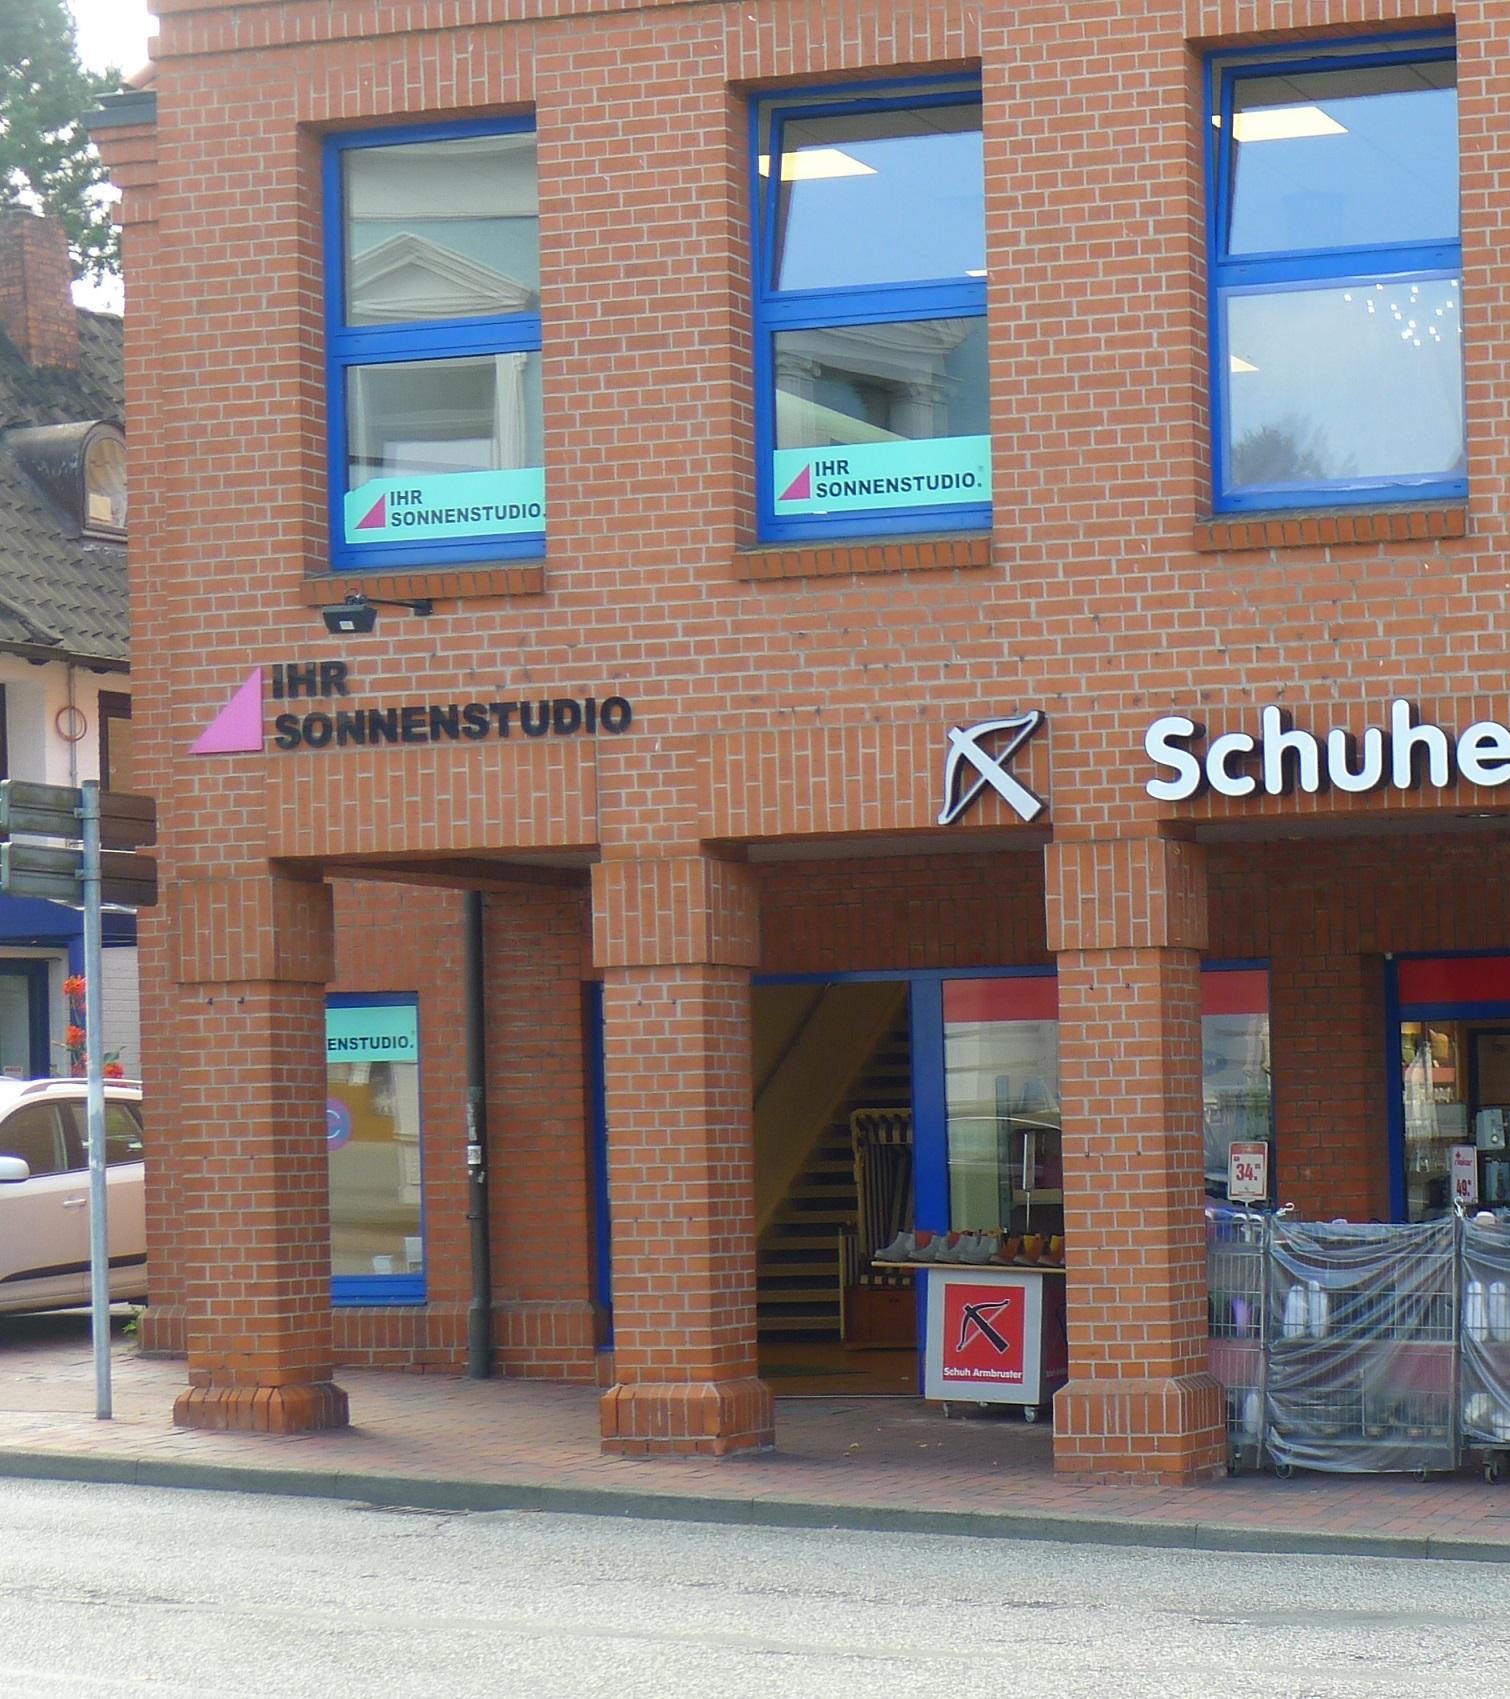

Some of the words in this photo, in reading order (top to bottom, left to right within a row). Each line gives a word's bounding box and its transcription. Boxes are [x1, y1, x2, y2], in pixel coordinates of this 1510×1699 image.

[814, 459, 850, 477] IHR
[815, 472, 983, 499] SONNENSTUDIO.
[389, 489, 424, 507] IHR
[271, 660, 351, 700] IHR
[273, 695, 633, 750] SONNENSTUDIO
[943, 1367, 971, 1377] Schuh
[972, 1368, 1024, 1379] Armbruster
